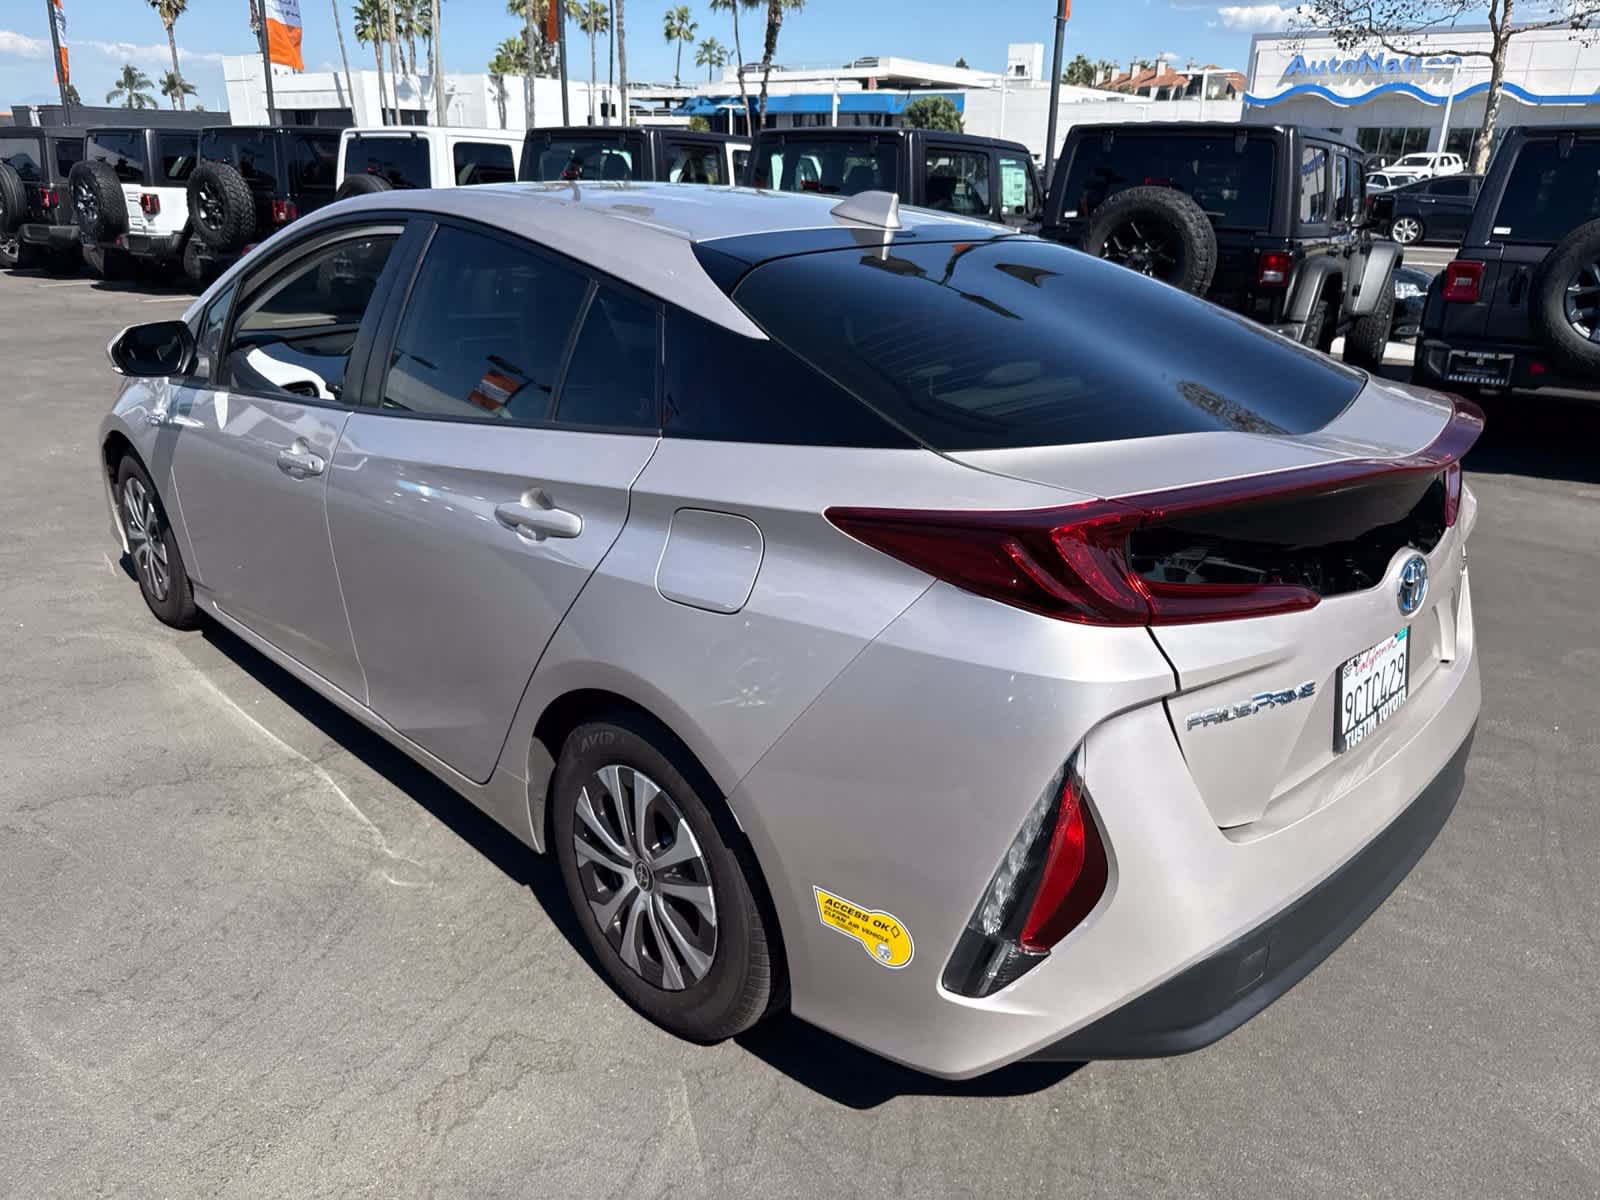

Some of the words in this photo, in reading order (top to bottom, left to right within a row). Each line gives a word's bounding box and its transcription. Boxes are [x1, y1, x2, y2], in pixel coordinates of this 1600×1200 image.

[1185, 702, 1252, 731] PRIUS
[1251, 680, 1315, 714] PRIME
[1345, 712, 1378, 751] TUSTIN
[1378, 687, 1407, 724] TOYOTA
[824, 898, 870, 922] ACCESS
[872, 919, 891, 932] OK
[848, 920, 860, 931] AIR
[861, 927, 889, 943] VEHICLE
